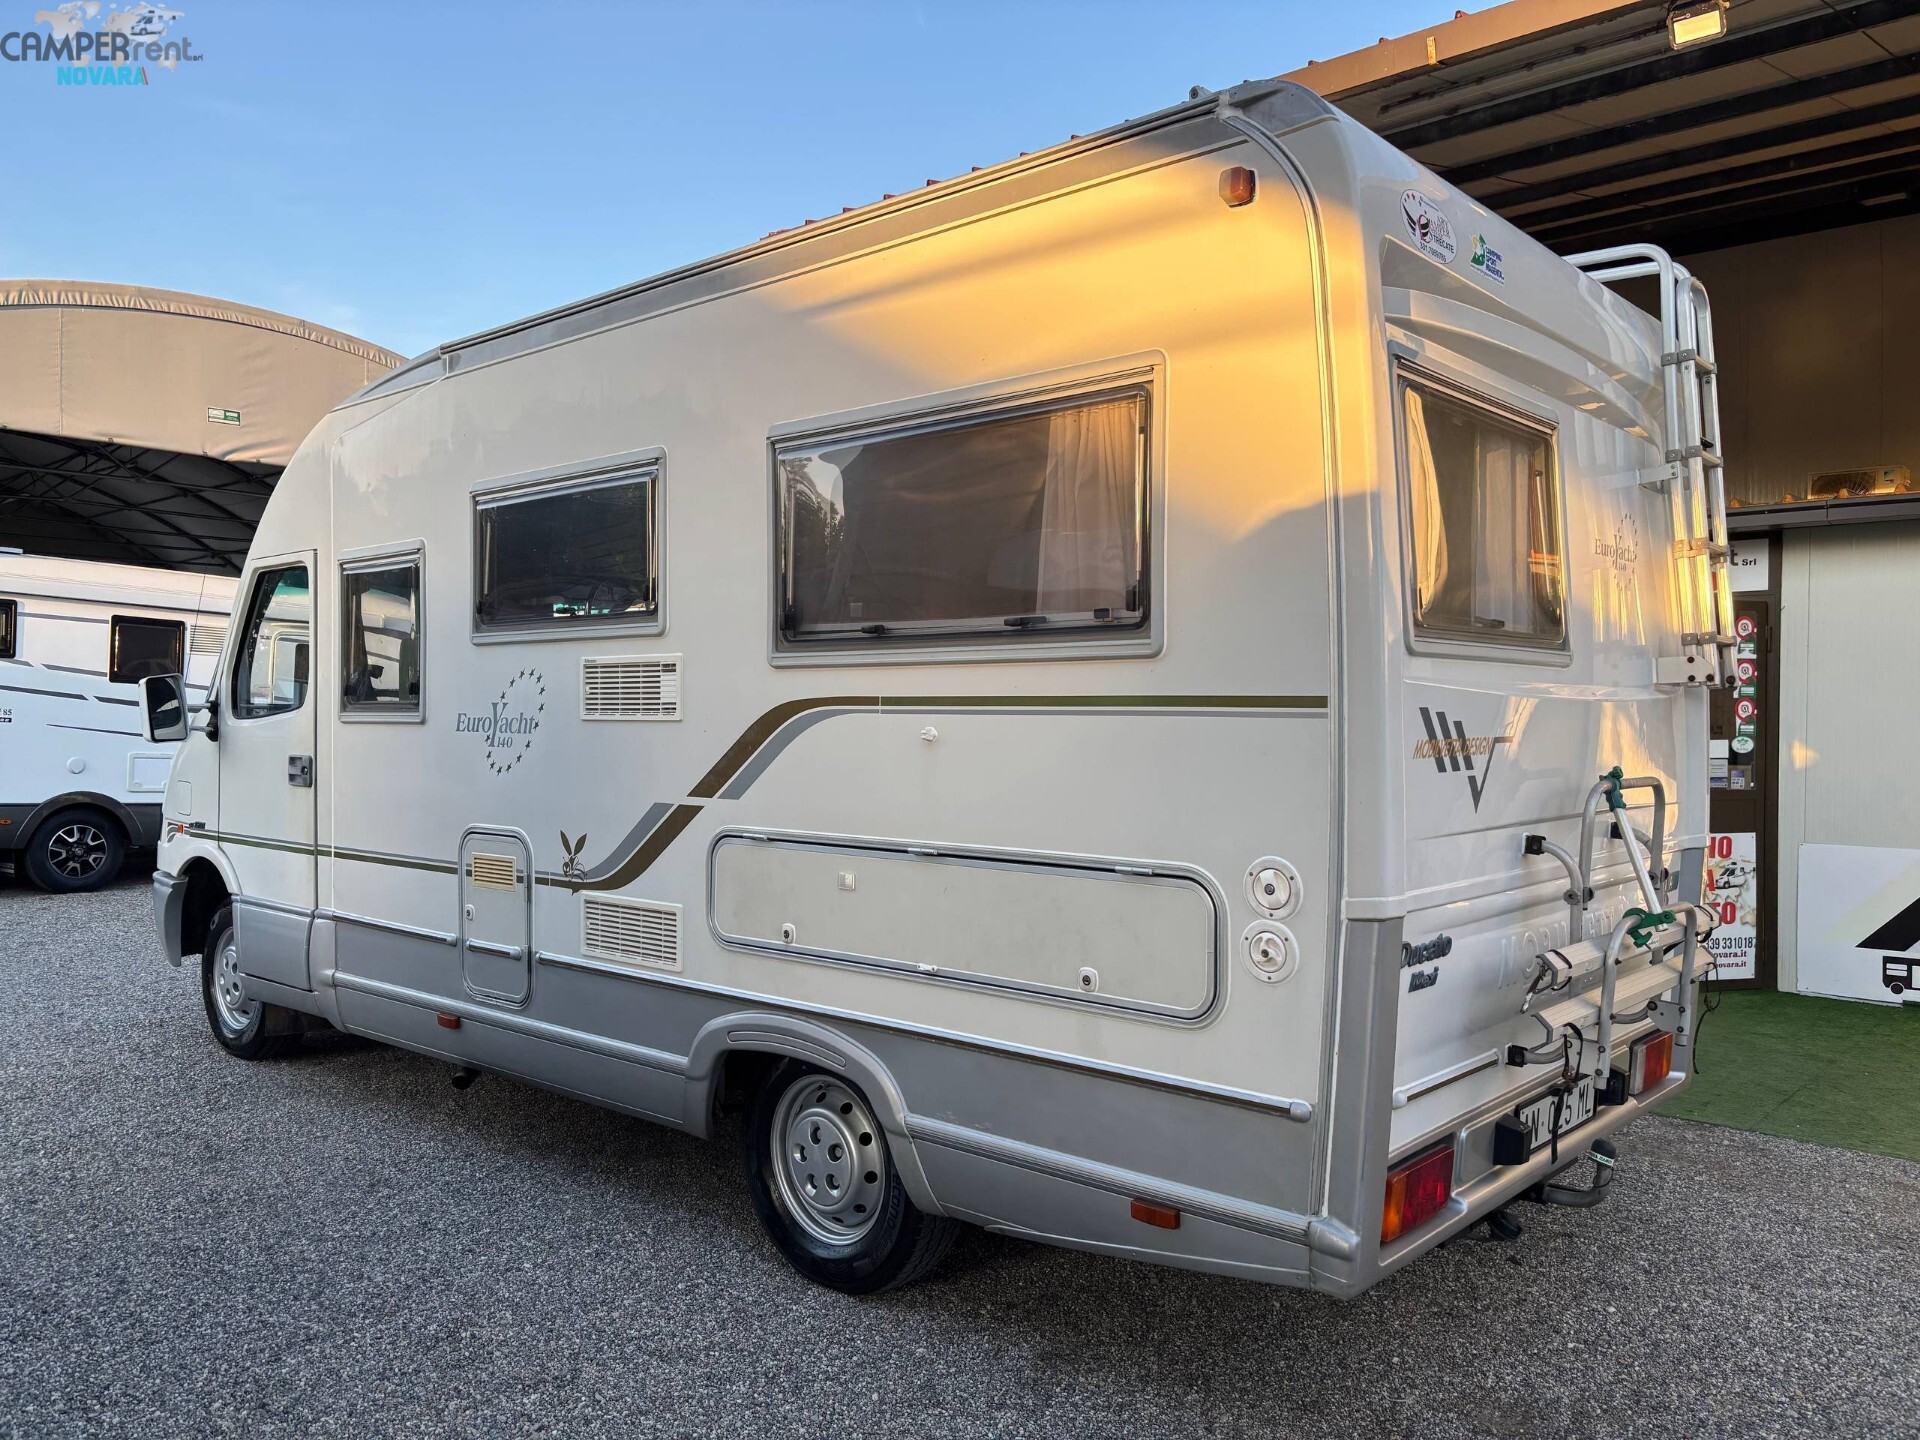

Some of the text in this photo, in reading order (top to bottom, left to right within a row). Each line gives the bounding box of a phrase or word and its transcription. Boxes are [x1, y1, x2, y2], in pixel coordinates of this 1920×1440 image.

[1741, 558, 1757, 566] Srl
[456, 702, 535, 747] EuroYacht
[497, 737, 513, 748] 140
[1463, 736, 1494, 757] DESIGN
